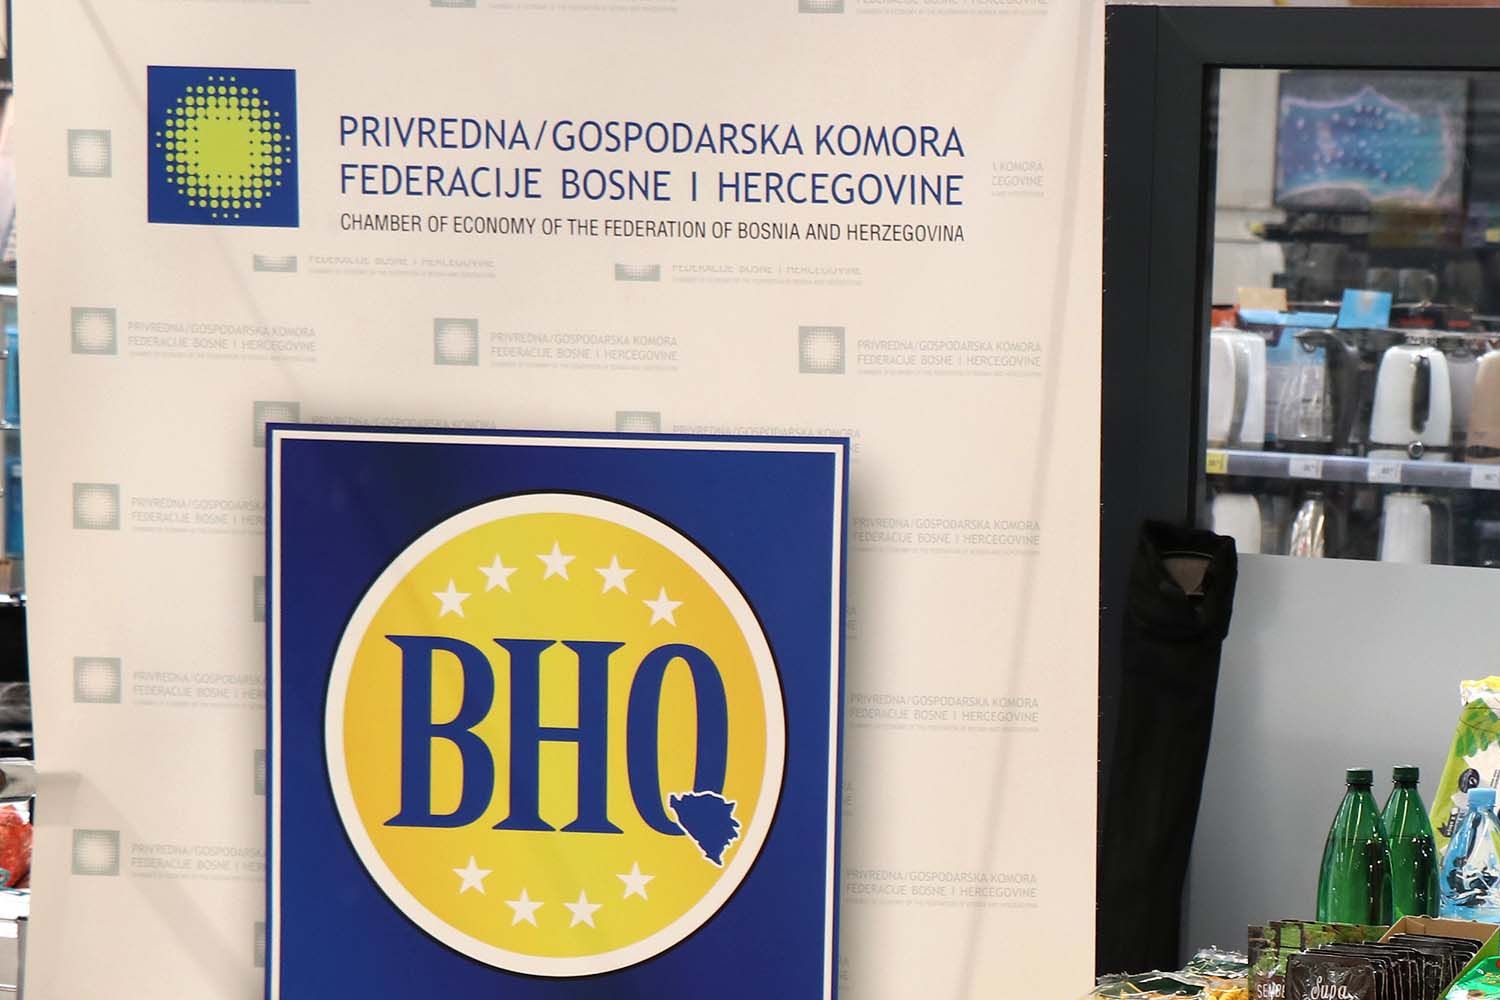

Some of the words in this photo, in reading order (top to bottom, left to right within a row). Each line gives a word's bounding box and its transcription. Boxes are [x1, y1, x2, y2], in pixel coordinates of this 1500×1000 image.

[340, 115, 804, 155] PRIVREDNA/GOSPODARSKA
[816, 124, 965, 158] KOMORA
[341, 163, 542, 199] FEDERACIJE
[562, 168, 671, 201] BOSNE
[692, 171, 697, 202] I
[719, 171, 964, 206] HERCEGOVINE
[341, 213, 421, 232] CHAMBER
[428, 215, 448, 233] OF
[453, 216, 536, 234] ECONOMY
[542, 217, 562, 235] OF
[567, 218, 599, 236] THE
[604, 219, 706, 238] FEDERATION
[712, 221, 732, 239] OF
[738, 222, 800, 240] BOSNIA
[805, 223, 841, 241] AND
[846, 224, 965, 242] HERZEGOVINA
